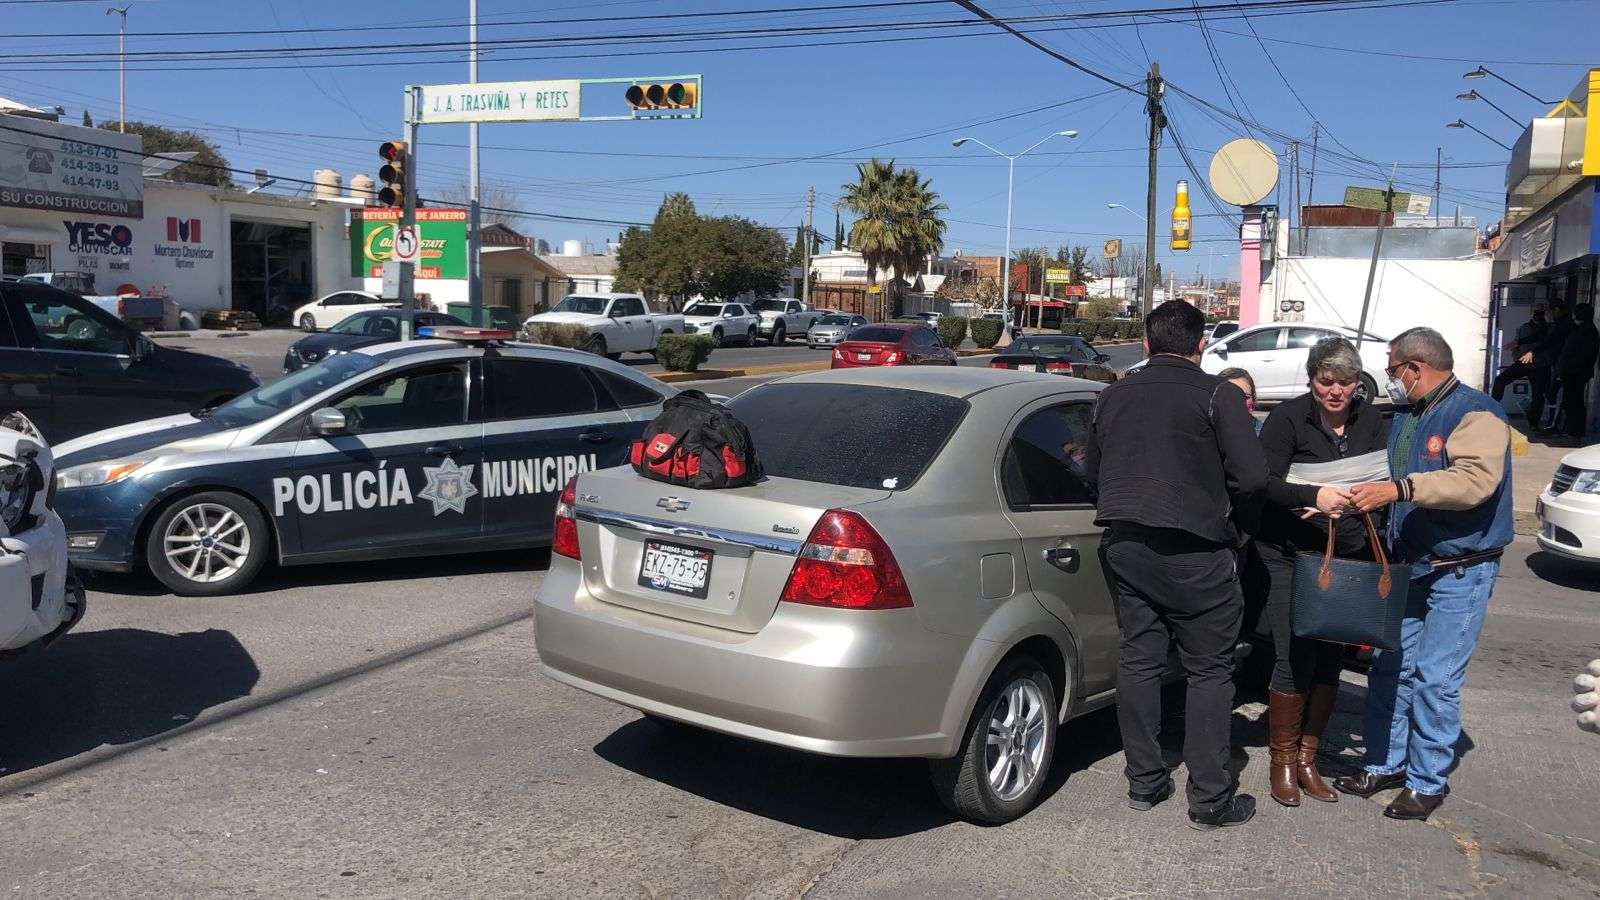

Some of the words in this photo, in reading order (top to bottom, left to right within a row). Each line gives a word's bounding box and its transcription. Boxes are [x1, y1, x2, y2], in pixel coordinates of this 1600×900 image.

[446, 95, 456, 112] A.
[461, 90, 511, 111] TRASVIÑA
[519, 92, 527, 109] Y
[536, 91, 569, 109] RETES
[61, 159, 119, 175] 414-39-12
[0, 191, 20, 203] SU
[24, 193, 128, 213] CONSTRUCCION
[430, 211, 466, 220] JANEIRO
[62, 221, 133, 248] YESO
[68, 243, 133, 256] CHUVISCAR
[272, 460, 413, 517] POLICÍA
[644, 551, 708, 581] EKZ-75-95
